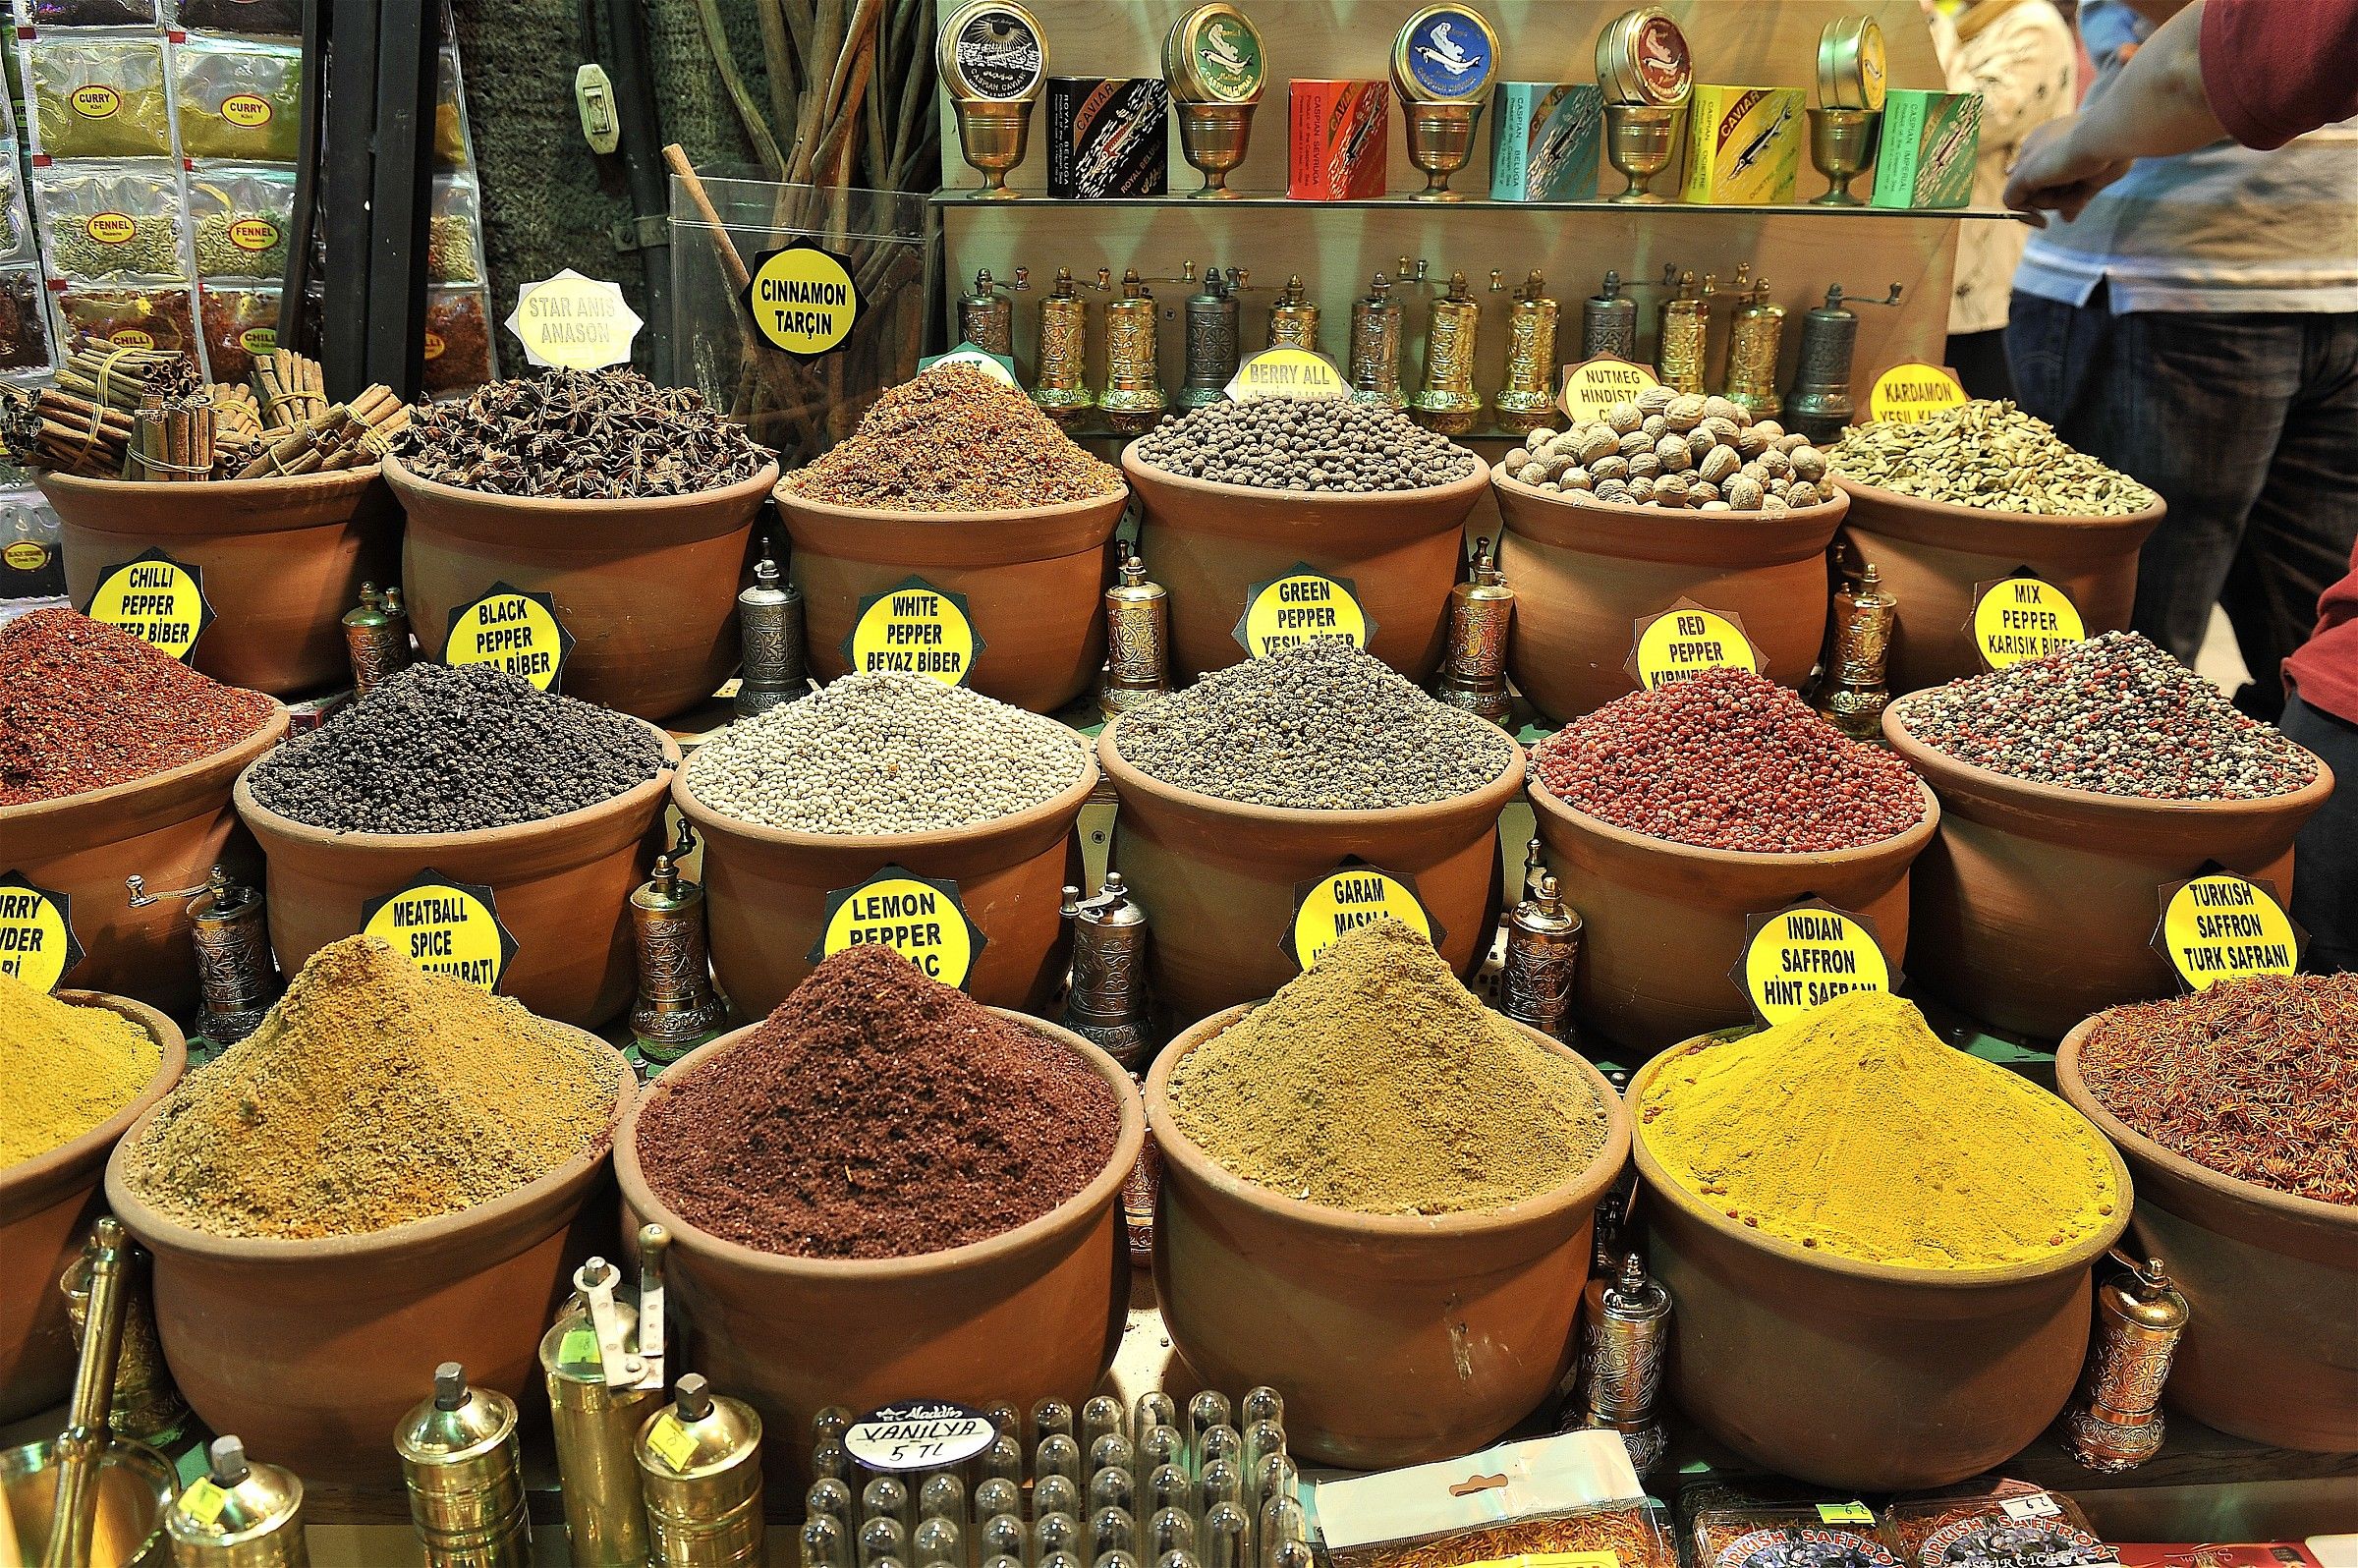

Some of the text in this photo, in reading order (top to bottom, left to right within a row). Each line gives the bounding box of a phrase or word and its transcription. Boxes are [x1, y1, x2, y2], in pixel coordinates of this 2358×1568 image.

[79, 93, 110, 103] CURRY
[230, 102, 262, 113] CURRY
[1077, 83, 1114, 131] CAVIAR
[1533, 86, 1564, 132] CAAR
[1705, 100, 1713, 140] CASPIAN
[1721, 90, 1761, 138] CAVIAR
[1906, 102, 1918, 143] CASPIAN
[94, 220, 130, 230] FENNEL
[236, 227, 273, 237] FENNEL
[760, 279, 846, 307] CINNAMON
[529, 297, 615, 317] STAR ANIS
[542, 322, 609, 344] ANASON
[774, 310, 831, 340] TARÇIN
[113, 336, 149, 346] CHILLI
[1250, 364, 1330, 385] BERRY ALL
[1586, 369, 1641, 384] NUTMEG
[1580, 385, 1639, 403] HİNDİST
[1884, 383, 1953, 403] KARDAMON
[130, 568, 174, 588] CHILLI
[1279, 582, 1330, 602] GREEN
[2014, 585, 2042, 604] MIX
[122, 594, 174, 615] PEPPER
[478, 599, 528, 625] BLACK
[892, 595, 938, 617] WHITE
[1277, 607, 1336, 629] PEPPER
[1677, 616, 1706, 637] RED
[2002, 609, 2058, 631] PEPPER
[477, 627, 533, 654] PEPPER
[886, 624, 942, 644] PEPPER
[2042, 633, 2075, 655] BİB
[867, 652, 914, 672] BEYAZ
[1669, 643, 1723, 662] PEPPER
[1334, 878, 1385, 904] GARAM
[2189, 882, 2254, 907] TURKISH
[0, 895, 43, 920] RRY
[393, 897, 468, 927] MEATBALL
[853, 892, 935, 922] LEMON
[850, 924, 941, 949] PEPPER
[1786, 916, 1843, 941] INDIAN
[2197, 914, 2264, 938] SAFFRON
[0, 927, 43, 951] DER
[411, 929, 452, 959] SPICE
[1781, 949, 1856, 974] SAFFRON
[2183, 944, 2289, 971] TURK SAFRANI
[905, 1405, 963, 1419] Aladdin
[889, 1442, 943, 1462] 5 TL
[1800, 1529, 1905, 1568] SAFFRO
[1924, 1515, 2112, 1568] URKISH SAFFRON
